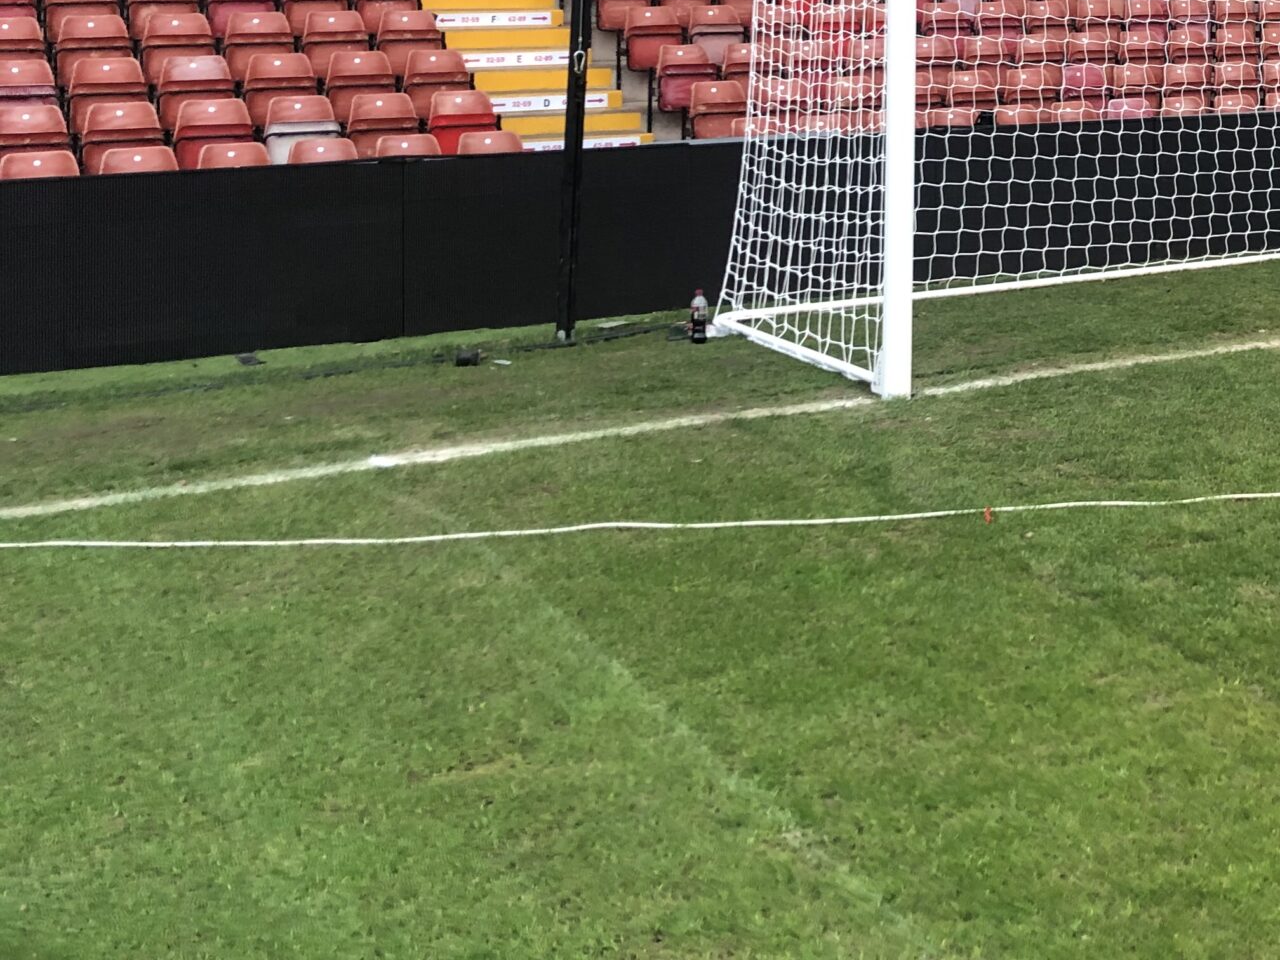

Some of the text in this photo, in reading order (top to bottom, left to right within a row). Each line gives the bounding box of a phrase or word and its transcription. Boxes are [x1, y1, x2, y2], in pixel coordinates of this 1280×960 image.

[491, 15, 497, 23] F
[516, 54, 522, 63] E
[543, 98, 550, 107] D
